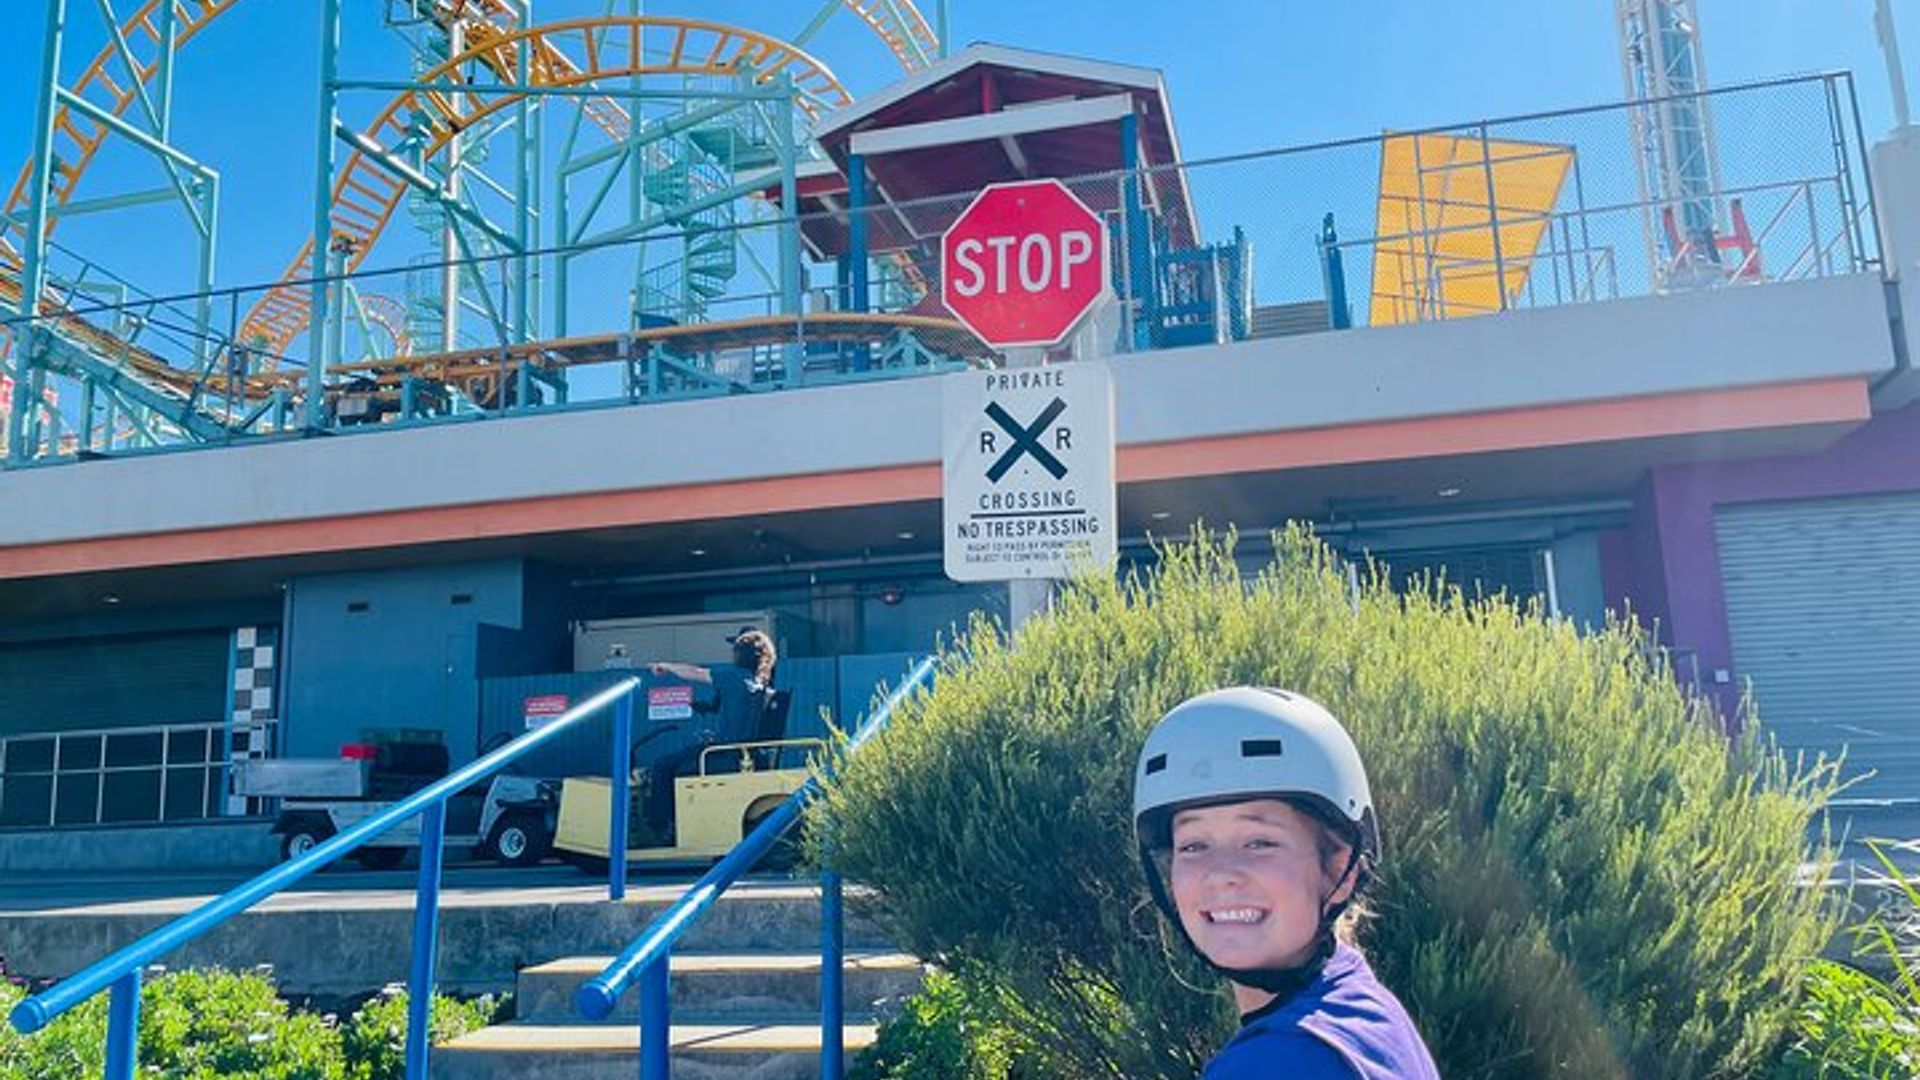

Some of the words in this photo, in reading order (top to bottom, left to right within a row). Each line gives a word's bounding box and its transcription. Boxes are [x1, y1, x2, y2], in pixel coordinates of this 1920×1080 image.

[954, 230, 1093, 297] STOP
[986, 370, 1065, 391] PRIVATE
[980, 431, 996, 453] R
[1056, 428, 1071, 450] R
[979, 490, 1077, 509] CROSSING
[957, 522, 980, 538] NO
[986, 517, 1100, 538] TRESPASSING
